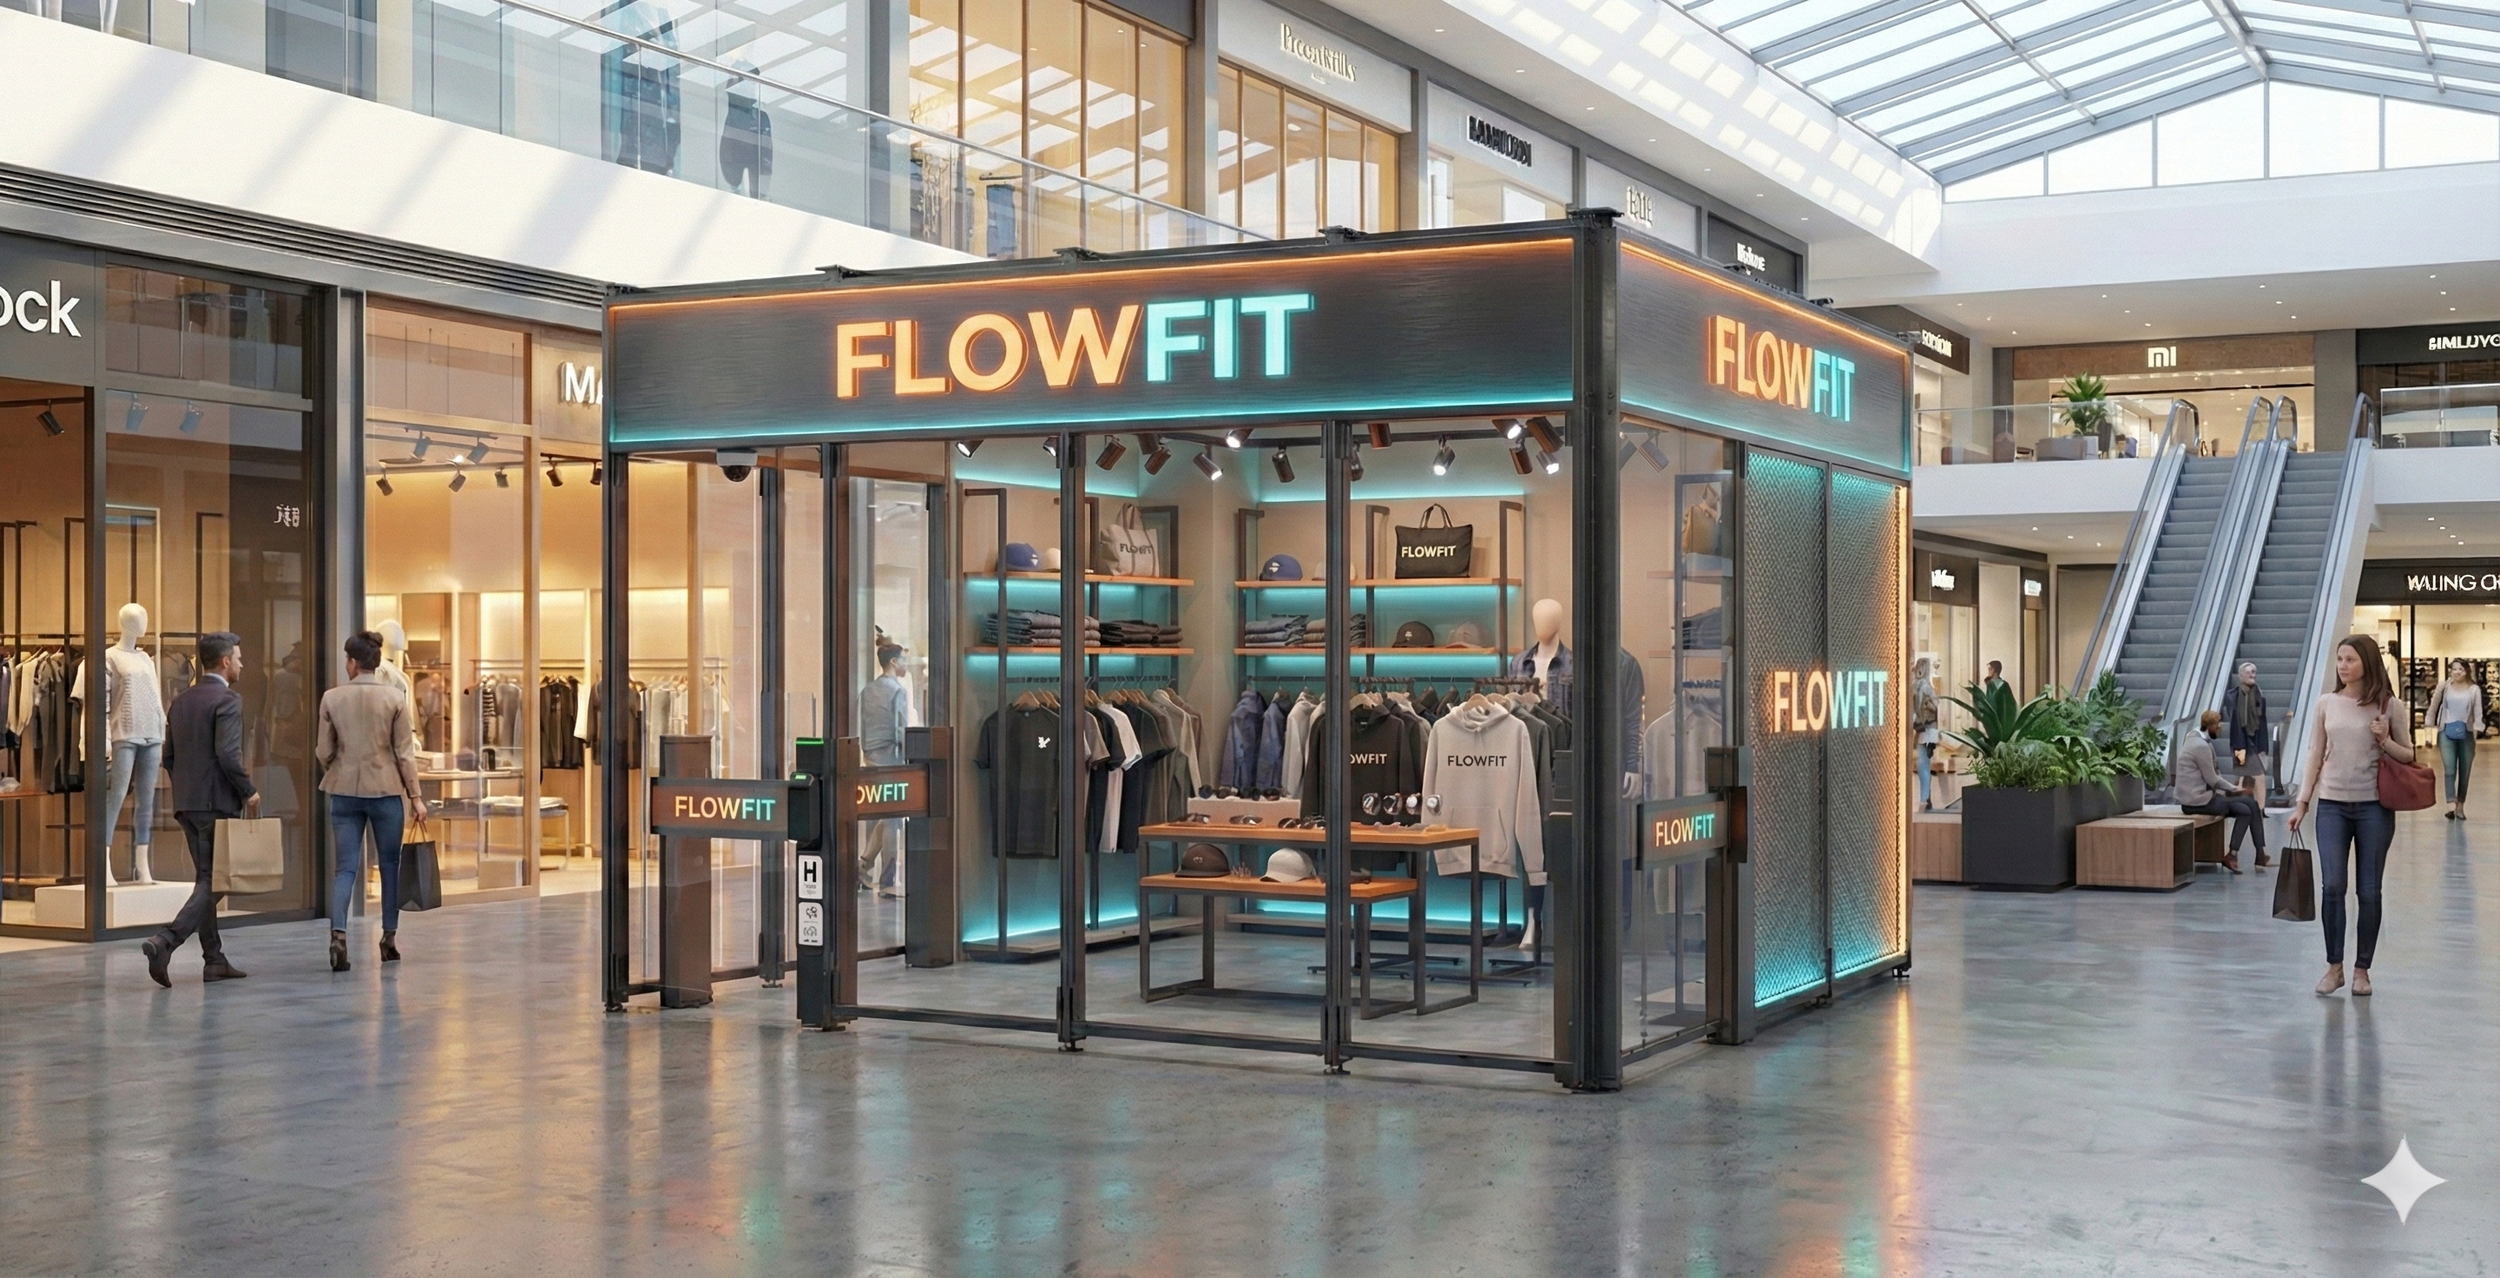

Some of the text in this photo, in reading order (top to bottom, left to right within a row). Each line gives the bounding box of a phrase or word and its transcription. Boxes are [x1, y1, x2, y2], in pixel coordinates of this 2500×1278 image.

[836, 293, 1314, 398] FLOWFIT
[1708, 314, 1855, 422] FLOWFIT
[1401, 545, 1457, 558] FLOWFIT
[1773, 670, 1889, 734] FLOWFIT
[1447, 754, 1507, 767] FLOWFIT
[674, 795, 776, 821] FLOWFIT
[1655, 813, 1715, 847] FLOWFIT
